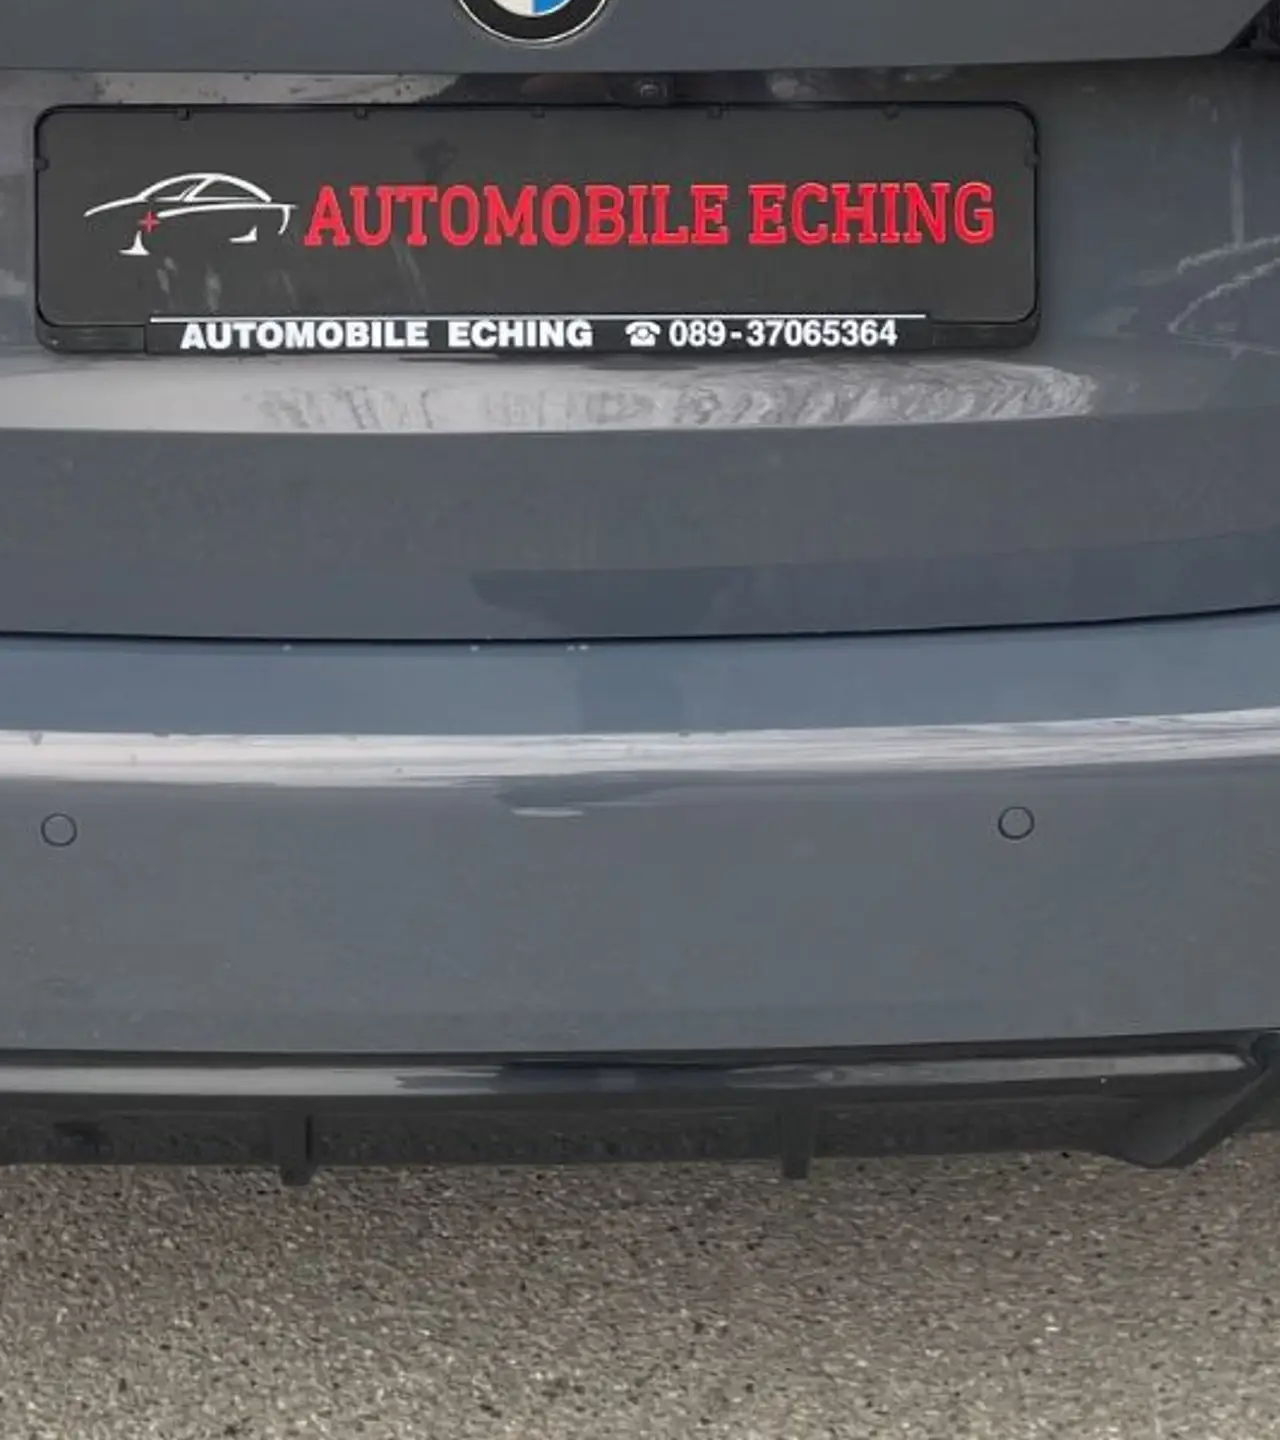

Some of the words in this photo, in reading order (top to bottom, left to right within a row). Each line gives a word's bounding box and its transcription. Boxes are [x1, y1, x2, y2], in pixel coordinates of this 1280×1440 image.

[303, 183, 729, 248] AUTOMOBILE
[747, 181, 995, 246] ECHING
[179, 320, 430, 350] AUTOMOBILE
[447, 319, 594, 348] ECHING
[668, 319, 899, 348] 089-37065364
